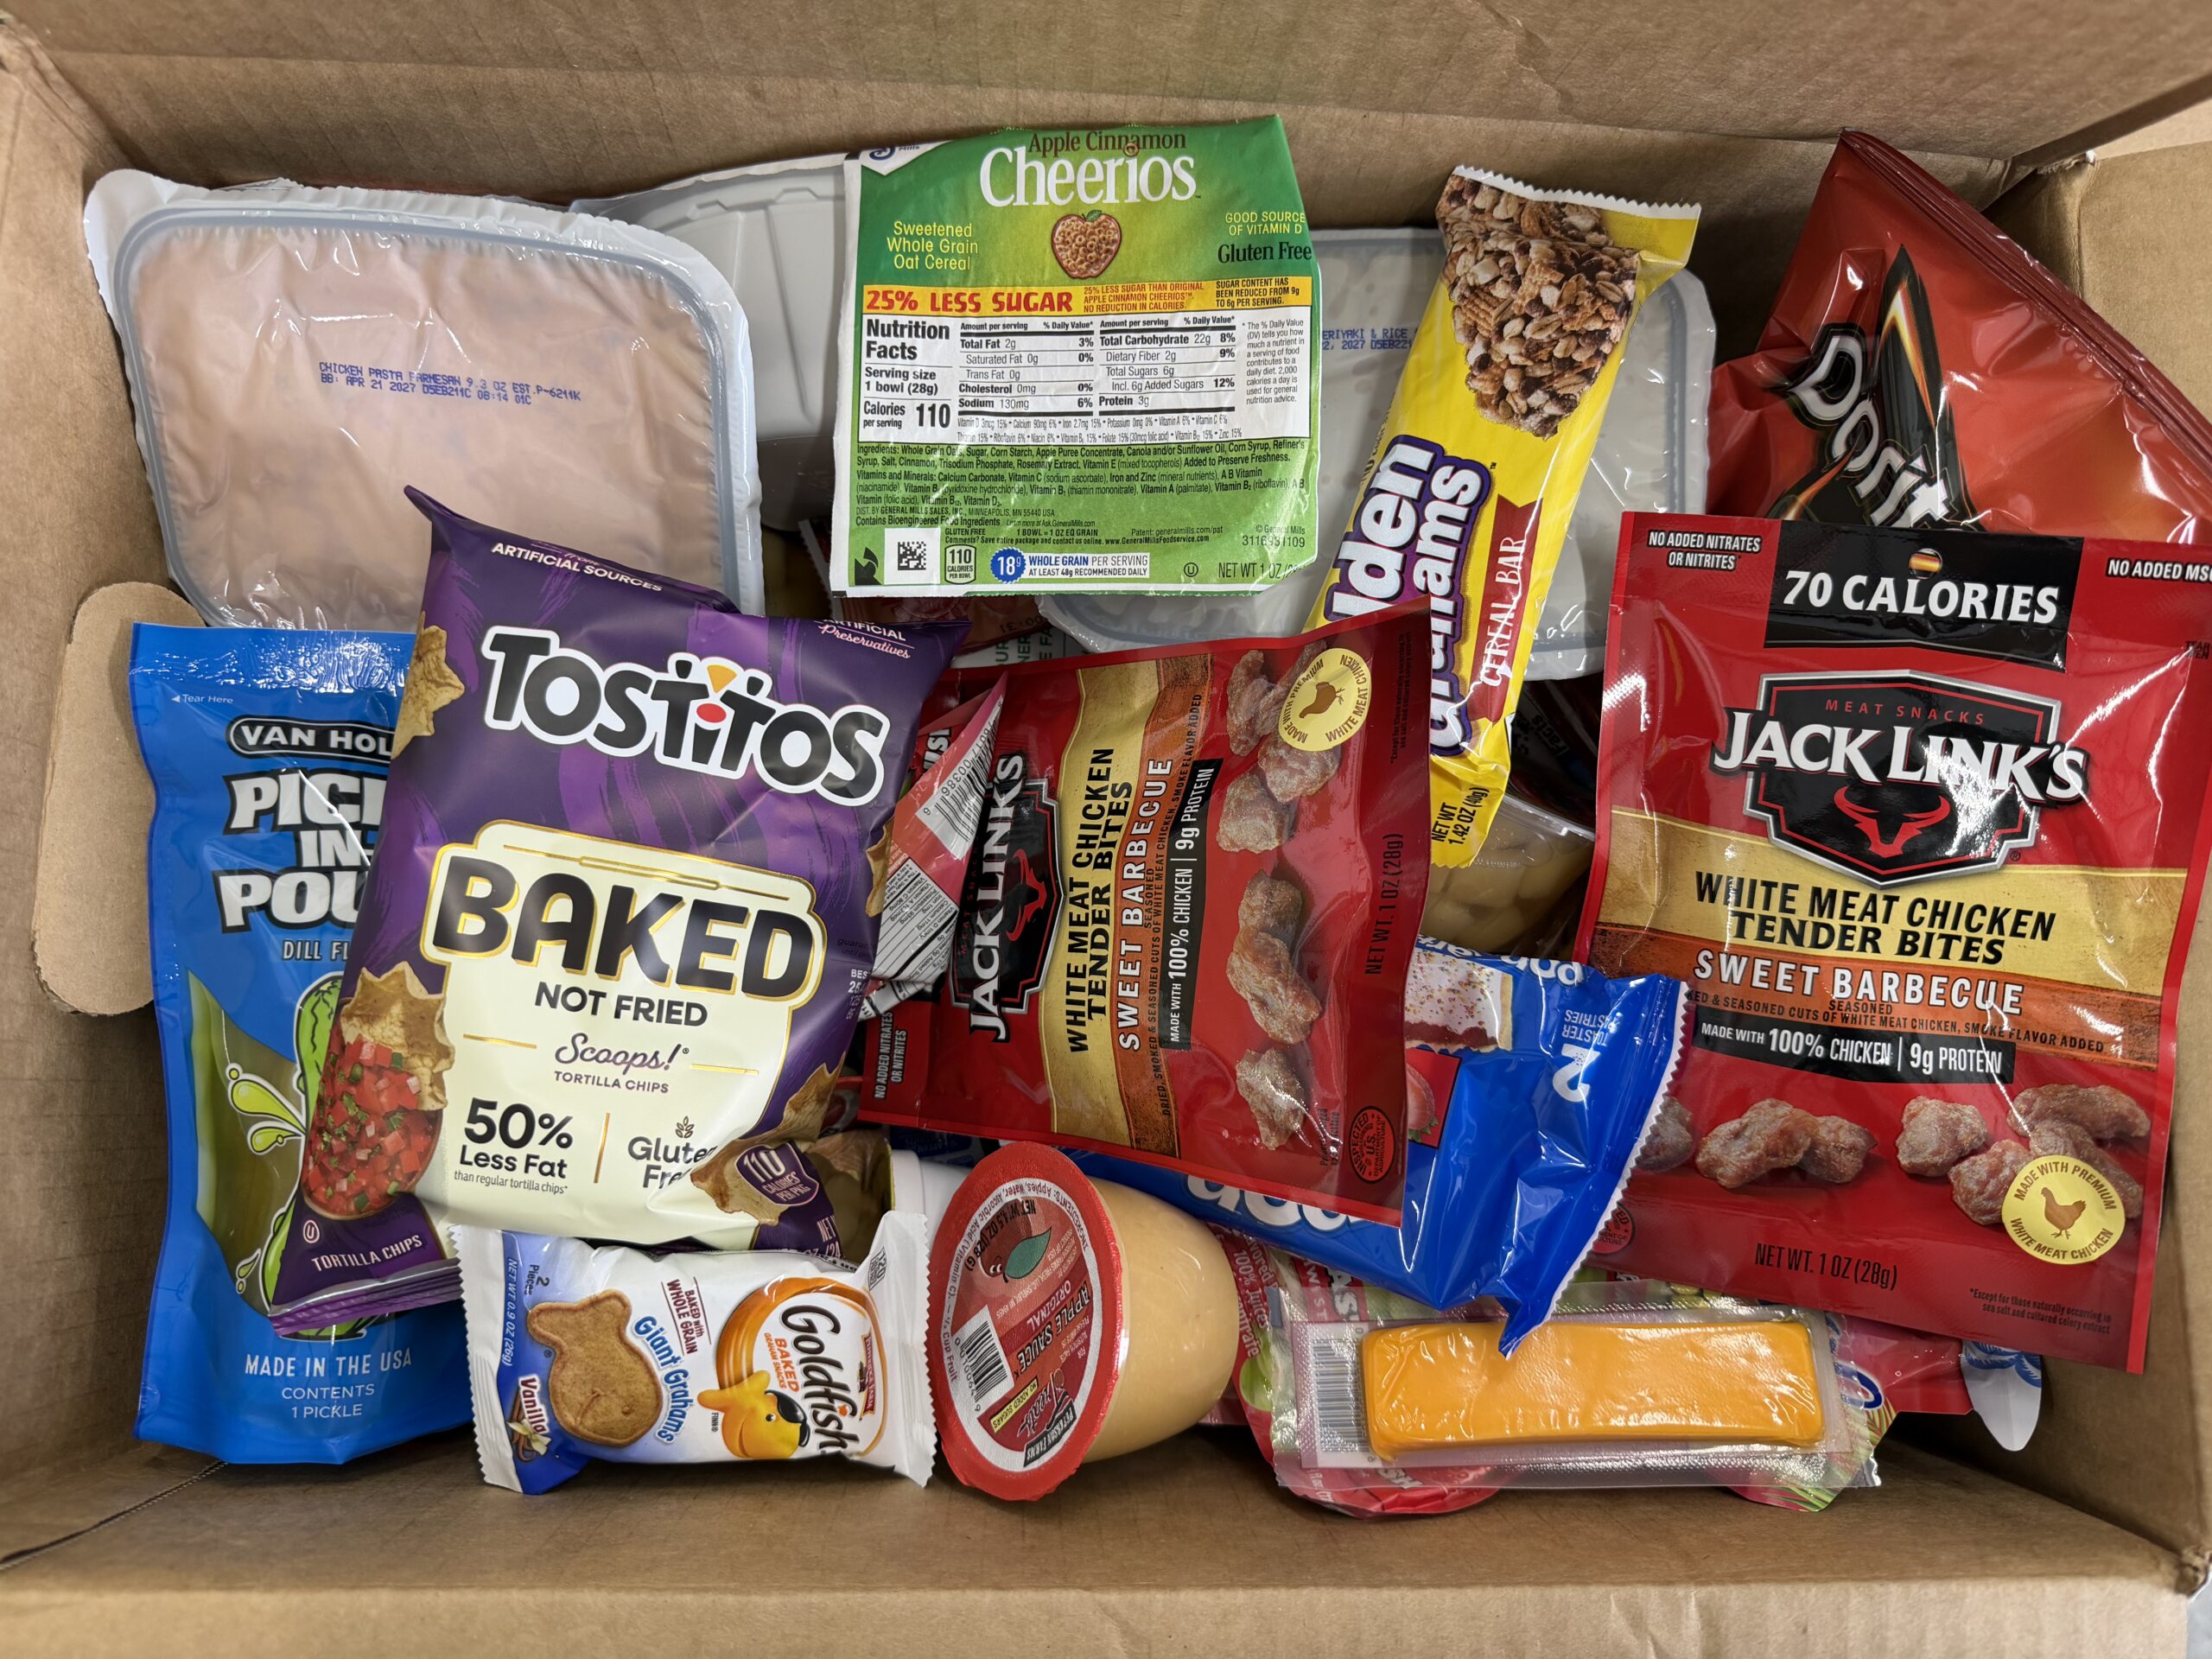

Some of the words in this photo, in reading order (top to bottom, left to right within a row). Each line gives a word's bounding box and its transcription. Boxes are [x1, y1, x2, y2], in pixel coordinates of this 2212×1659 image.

[1029, 133, 1081, 157] Apple
[1086, 130, 1186, 151] Cinnamon
[980, 143, 1196, 207] Cheerios
[893, 221, 973, 238] Sweetened
[1225, 213, 1255, 223] GOOD
[1259, 212, 1306, 223] SOURCE
[1230, 225, 1243, 235] OF
[1246, 224, 1291, 234] VITAMIN
[1295, 223, 1302, 233] D
[887, 238, 933, 253] Whole
[939, 239, 978, 254] Grain
[1217, 244, 1274, 264] Gluten
[1279, 242, 1312, 261] Free
[894, 255, 919, 270] Oat
[925, 256, 971, 270] Cereal
[867, 289, 918, 312] 25%
[931, 292, 982, 312] LESS
[993, 292, 1073, 313] SUGAR
[867, 319, 950, 339] Nutrition
[1079, 338, 1093, 347] 3%
[1100, 336, 1122, 346] Total
[1124, 334, 1189, 346] Carbohydrate
[1194, 334, 1211, 345] 22g
[1220, 333, 1236, 343] 8%
[1322, 328, 1364, 340] ERIYAKI
[1370, 329, 1376, 339] &
[1382, 328, 1408, 338] RICE
[866, 340, 917, 359] Facts
[961, 339, 982, 348] Total
[985, 339, 1000, 348] Fat
[1006, 339, 1015, 350] 2g
[319, 362, 363, 377] CHICKEN
[369, 367, 403, 381] PASTA
[346, 376, 365, 387] APR
[371, 378, 382, 390] 21
[390, 380, 416, 393] 2027
[865, 367, 908, 380] Serving
[912, 369, 936, 380] size
[865, 382, 871, 391] 1
[876, 382, 904, 392] bowl
[908, 384, 938, 396] (28g)
[1099, 395, 1133, 405] Protein
[1138, 396, 1149, 407] 3g
[864, 401, 905, 416] Calories
[916, 404, 950, 428] 110
[863, 419, 874, 429] per
[876, 419, 902, 429] serving
[1786, 334, 1949, 528] Dorit
[1330, 442, 1436, 620] lden
[1649, 531, 1664, 546] NO
[1667, 533, 1704, 549] ADDED
[1707, 534, 1761, 552] NITRATES
[492, 542, 582, 572] ARTIFICIAL
[584, 563, 663, 592] SOURCES
[1029, 556, 1059, 566] WHOLE
[1062, 556, 1089, 566] GRAIN
[1092, 556, 1109, 566] PER
[1111, 556, 1147, 565] SERVING
[1495, 535, 1527, 586] BAR
[1669, 551, 1681, 566] OR
[1783, 570, 1833, 607] 70
[1842, 575, 2059, 624] CALORIES
[818, 624, 911, 658] Preservatives
[1482, 592, 1520, 688] CEREAL
[182, 693, 204, 703] Tear
[1826, 699, 1884, 715] MEAT
[1897, 705, 1985, 725] SNACKS
[489, 632, 882, 800] TOSTITOS
[240, 725, 315, 747] VAN
[330, 729, 394, 755] HOL
[1714, 712, 1885, 782] JACK
[1891, 726, 2088, 801] LINK'S
[1072, 748, 1115, 868] CHICKEN
[1437, 802, 1458, 821] WT
[1457, 807, 1476, 823] OZ
[977, 753, 1023, 902] LINK'S
[1092, 781, 1132, 871] BITES
[1432, 821, 1450, 842] NET
[1448, 824, 1470, 844] 1.42
[1122, 759, 1173, 927] BARBECUE
[219, 871, 369, 927] POU
[1695, 871, 1799, 914] WHITE
[1809, 887, 1900, 925] MEAT
[1906, 897, 2056, 941] CHICKEN
[432, 855, 816, 1001] BAKED
[1068, 876, 1090, 956] MEAT
[283, 940, 321, 960] DILL
[1088, 883, 1111, 1020] TENDER
[1730, 910, 1882, 954] TENDER
[1895, 929, 2005, 964] BITES
[969, 906, 1009, 1042] JACK
[1693, 949, 1820, 995] SWEET
[1834, 967, 2024, 1015] BARBECUE
[535, 982, 606, 1016] NOT
[614, 995, 708, 1027] FRIED
[1062, 963, 1089, 1053] WHITE
[1118, 939, 1142, 1052] SWEET
[555, 1032, 682, 1075] Scoops!
[1701, 1022, 1733, 1039] MADE
[1735, 1027, 1764, 1044] WITH
[1770, 1028, 1824, 1058] 100%
[1830, 1038, 1891, 1065] CHICKEN
[1553, 1044, 1600, 1102] 2
[1910, 1043, 1933, 1074] 9g
[1939, 1047, 2003, 1074] PROTEIN
[555, 1071, 621, 1089] TORTILLA
[626, 1080, 669, 1094] CHIPS
[465, 1096, 573, 1149] 50%
[460, 1145, 518, 1172] Less
[524, 1154, 568, 1179] Fat
[628, 1135, 718, 1163] Gluten
[454, 1170, 474, 1183] than
[476, 1173, 509, 1186] regular
[510, 1178, 539, 1192] tortilla
[312, 1251, 382, 1272] TORTILLA
[382, 1234, 423, 1260] CHIPS
[1756, 1243, 1784, 1268] NET
[1787, 1249, 1815, 1273] WT.
[1830, 1254, 1852, 1280] OZ
[1853, 1256, 1897, 1291] (28g)
[508, 1258, 518, 1281] NET
[506, 1281, 518, 1300] WT
[507, 1302, 516, 1319] 0.9
[667, 1279, 690, 1319] WHOLE
[681, 1321, 698, 1354] GRAIN
[685, 1290, 701, 1319] BAKED
[695, 1319, 704, 1337] with
[1027, 1280, 1071, 1331] ORIGINAL
[1054, 1281, 1090, 1334] APPLE
[505, 1321, 515, 1335] OZ
[634, 1316, 683, 1367] Giant
[502, 1337, 514, 1366] (26g)
[1017, 1324, 1053, 1371] SAUCE
[245, 1353, 296, 1377] MADE
[305, 1357, 325, 1377] IN
[336, 1354, 371, 1376] THE
[380, 1348, 411, 1372] USA
[774, 1338, 799, 1392] BAKED
[781, 1305, 860, 1449] Goldfish
[282, 1383, 375, 1400] CONTENTS
[520, 1377, 548, 1433] Vanilla
[658, 1369, 694, 1442] Grahams
[291, 1407, 297, 1418] 1
[303, 1403, 363, 1418] PICKLE
